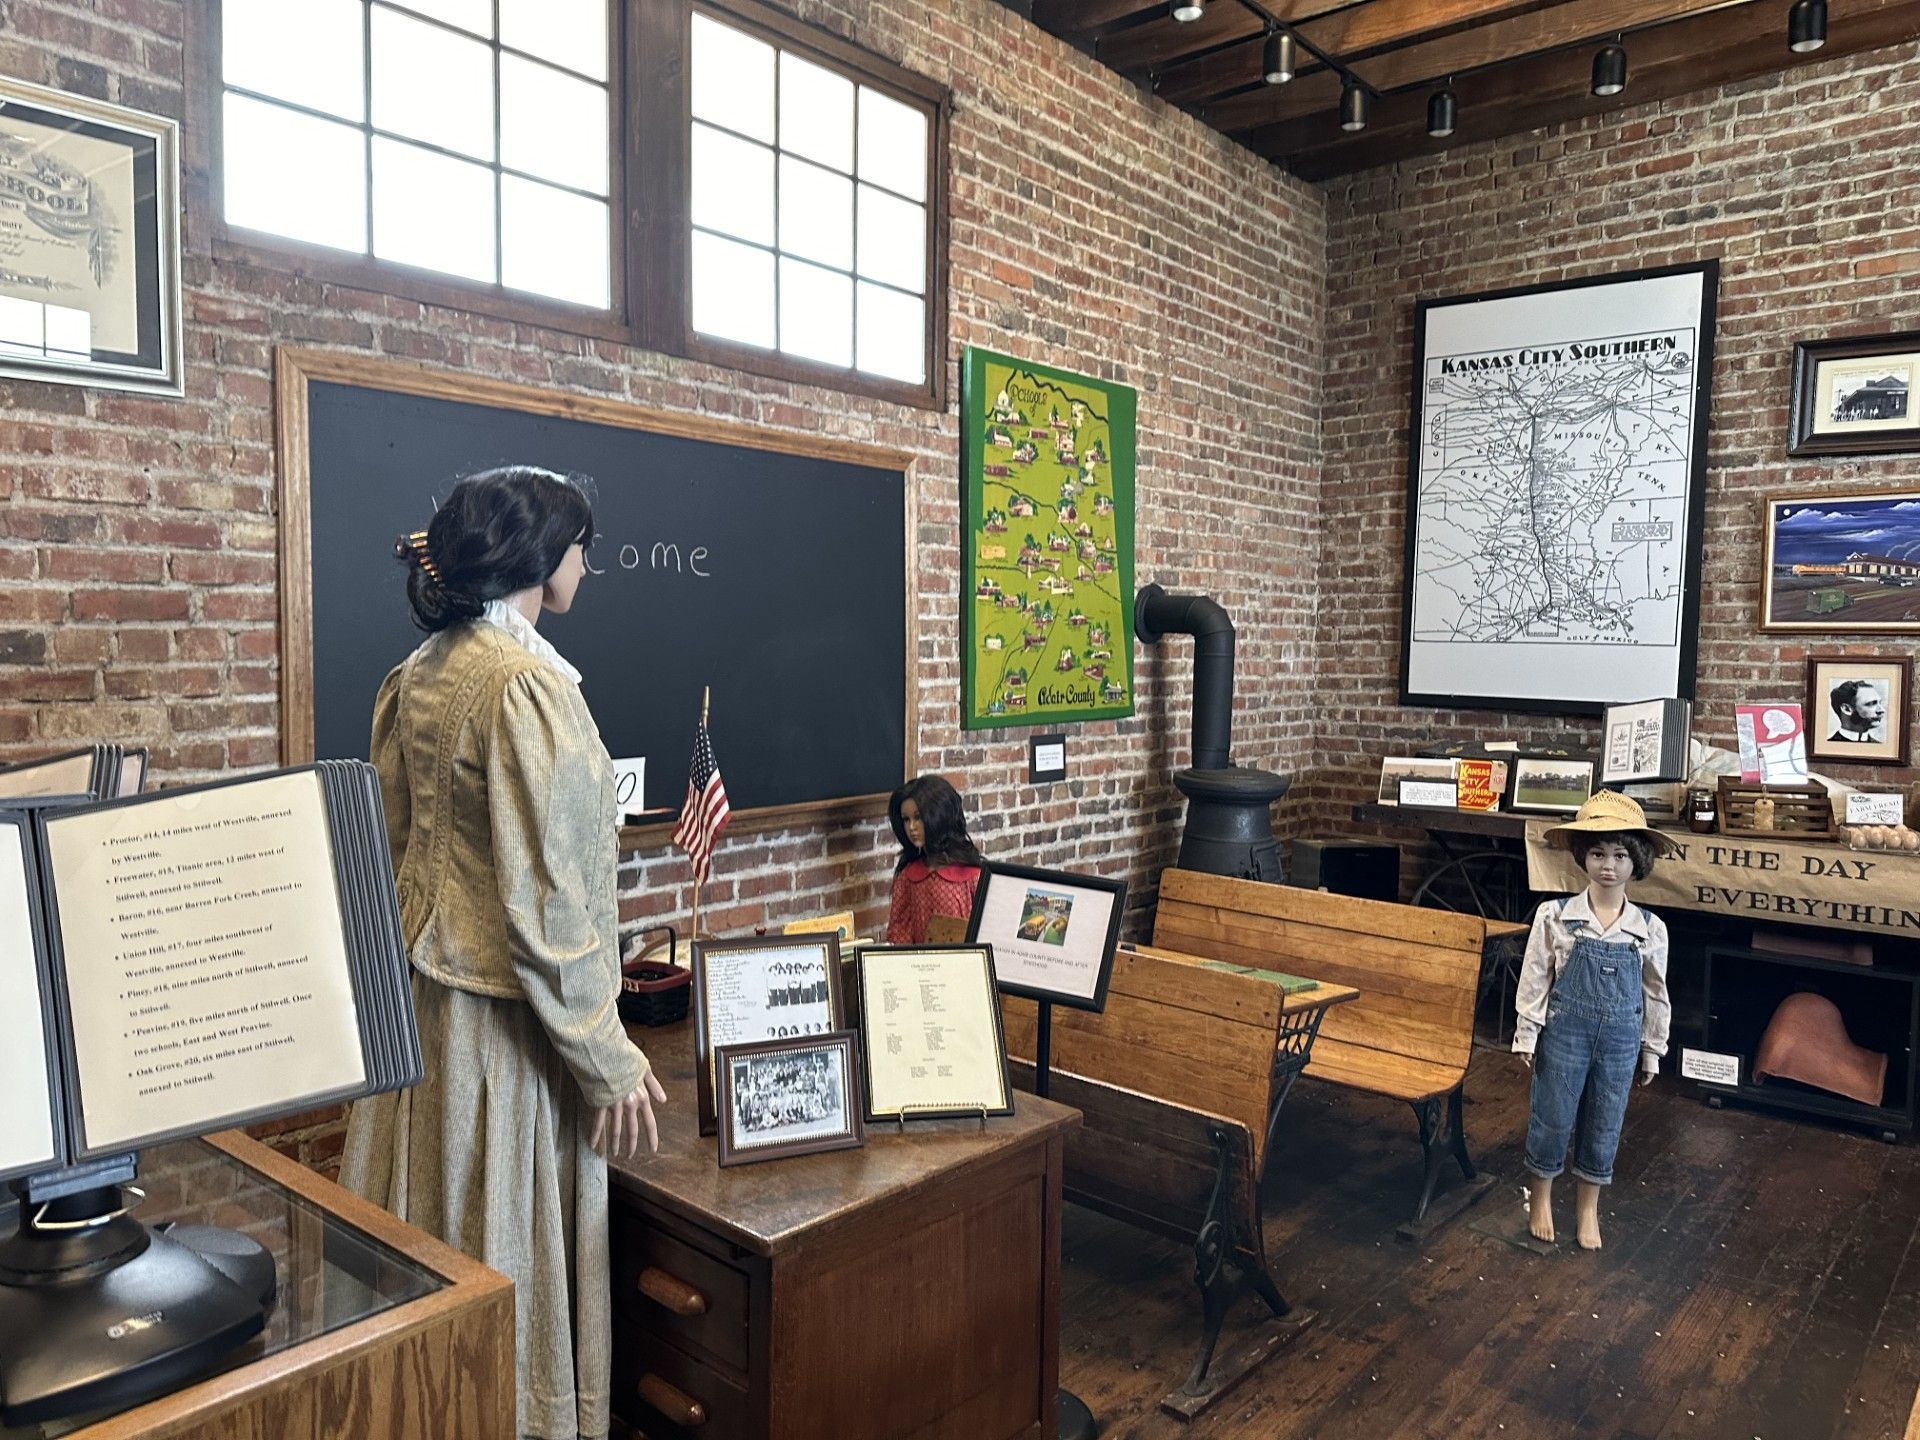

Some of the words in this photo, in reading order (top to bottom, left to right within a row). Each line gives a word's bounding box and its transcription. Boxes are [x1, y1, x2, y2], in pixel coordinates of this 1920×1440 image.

[1441, 354, 1514, 374] KANSAS
[1519, 348, 1565, 366] CITY
[1569, 335, 1677, 360] SOUTHERN
[1037, 683, 1065, 706] Adair
[1065, 683, 1096, 708] County
[1460, 764, 1490, 778] KANSAS
[615, 772, 637, 805] 0
[110, 836, 142, 845] Proctor,
[173, 827, 193, 835] miles
[195, 824, 211, 832] west
[223, 815, 259, 827] Westville,
[261, 809, 292, 820] annexed
[111, 857, 121, 866] by
[124, 851, 161, 862] Westville.
[237, 853, 256, 862] miles
[258, 850, 274, 858] west
[276, 846, 284, 854] of
[1706, 846, 1780, 871] THE
[1801, 855, 1876, 881] DAY
[115, 891, 147, 902] Stilwell,
[149, 884, 182, 896] annexed
[119, 913, 146, 922] Baron,
[214, 896, 233, 904] Fork
[234, 891, 259, 901] Creek,
[260, 885, 292, 894] annexed
[121, 927, 159, 940] Westville.
[123, 949, 147, 960] Union
[186, 938, 202, 948] four
[204, 935, 224, 944] miles
[225, 927, 263, 940] southwest
[264, 924, 273, 932] of
[125, 966, 164, 978] Westville,
[165, 958, 198, 971] annexed
[209, 948, 246, 962] Westville.
[127, 988, 152, 999] Piney,
[172, 981, 188, 990] nine
[190, 976, 210, 985] miles
[212, 971, 233, 980] north
[235, 968, 243, 977] of
[245, 962, 276, 974] Stilwell,
[277, 955, 308, 968] annexed
[189, 1017, 204, 1026] five
[205, 1012, 226, 1021] miles
[227, 1007, 248, 1017] north
[250, 1004, 259, 1012] of
[292, 993, 312, 1003] Once
[134, 1048, 149, 1056] two
[150, 1041, 181, 1054] schools,
[183, 1037, 201, 1046] East
[202, 1033, 217, 1041] and
[219, 1029, 238, 1038] West
[137, 1066, 153, 1076] Oak
[155, 1061, 183, 1072] Grove,
[216, 1050, 236, 1059] miles
[237, 1046, 253, 1054] east
[255, 1042, 263, 1050] of
[139, 1083, 172, 1095] annexed
[184, 1073, 215, 1085] Stilwell.
